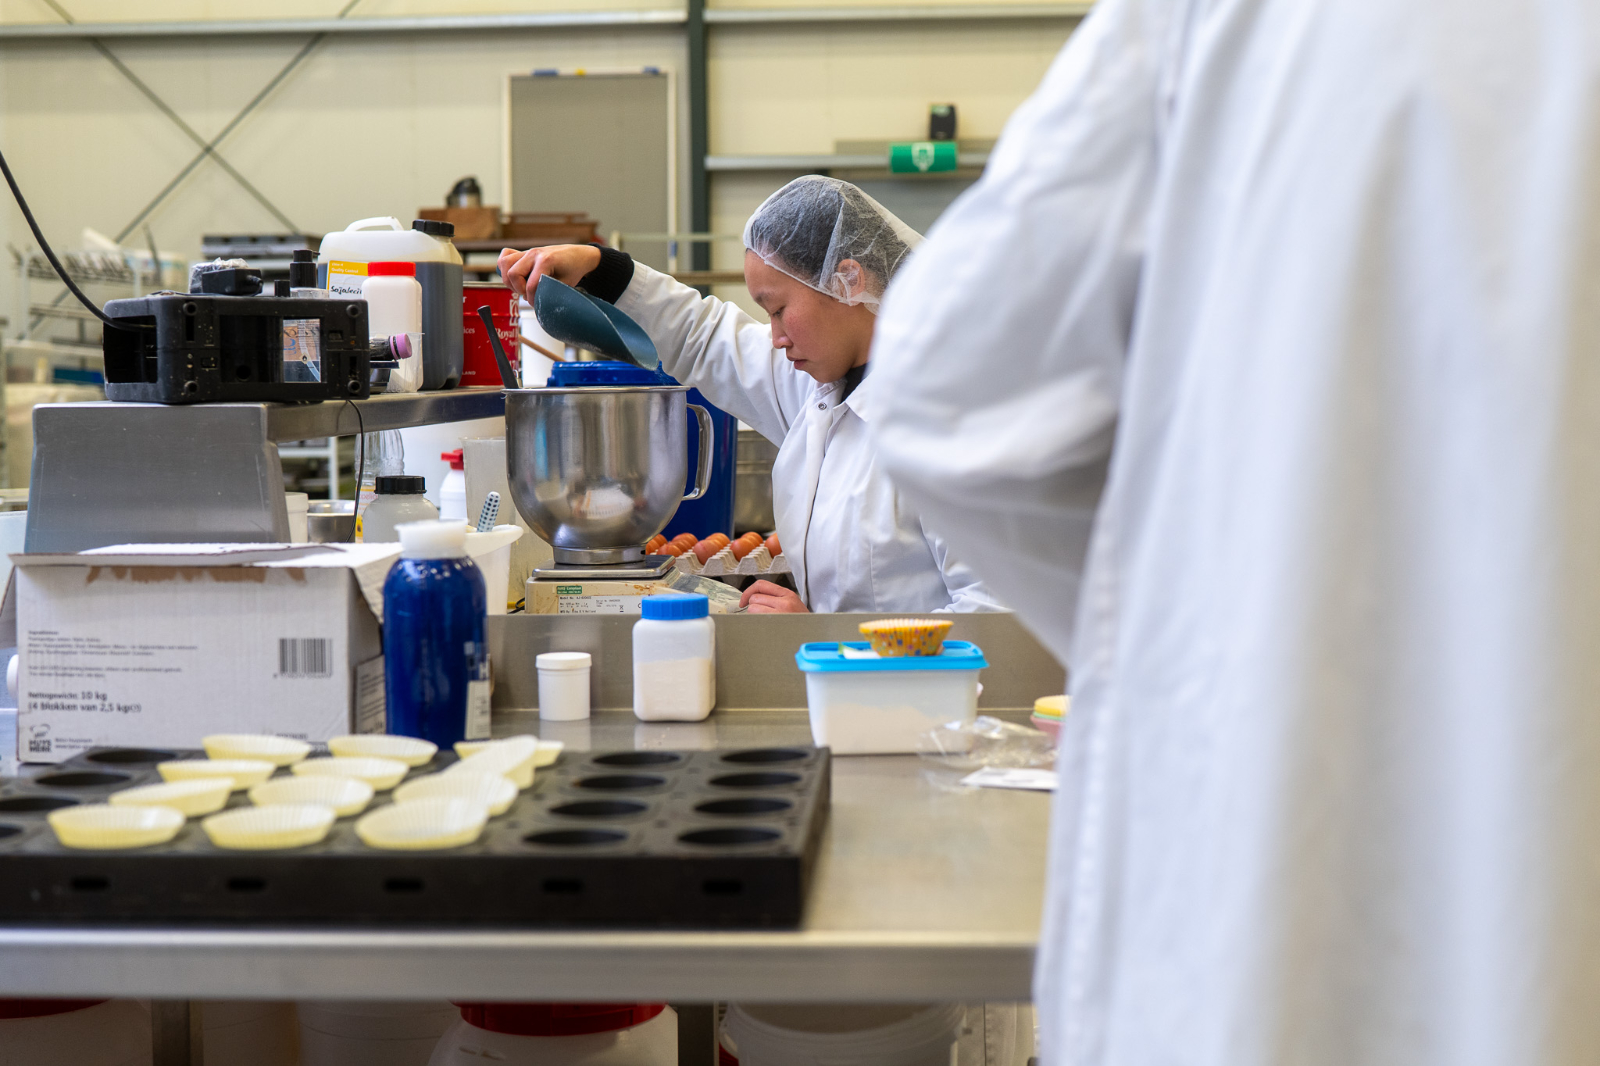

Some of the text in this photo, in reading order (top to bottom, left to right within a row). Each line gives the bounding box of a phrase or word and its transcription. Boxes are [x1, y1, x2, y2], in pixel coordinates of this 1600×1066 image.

[81, 691, 93, 700] 10
[95, 691, 108, 702] kg
[41, 702, 78, 712] blokken
[80, 704, 98, 712] van
[100, 703, 114, 713] 2,5
